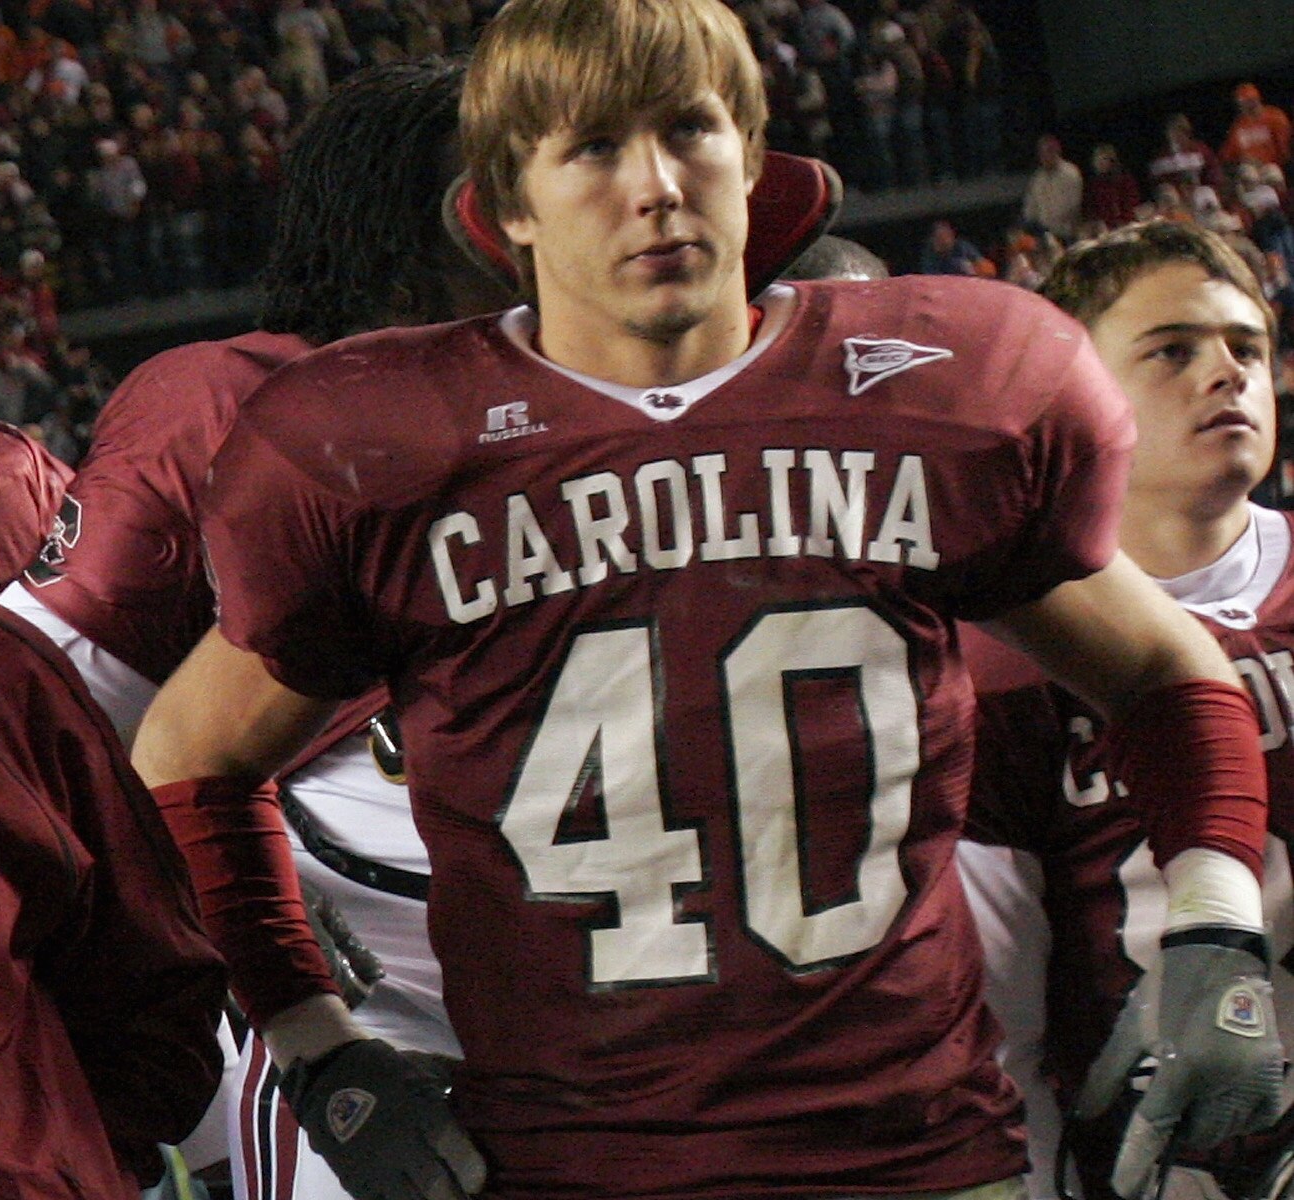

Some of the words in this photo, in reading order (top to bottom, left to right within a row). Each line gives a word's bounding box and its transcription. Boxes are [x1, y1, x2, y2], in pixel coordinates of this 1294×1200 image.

[478, 423, 548, 443] RUSSELL
[487, 401, 529, 431] R
[428, 448, 940, 625] CAROLINA
[500, 604, 920, 985] 40
